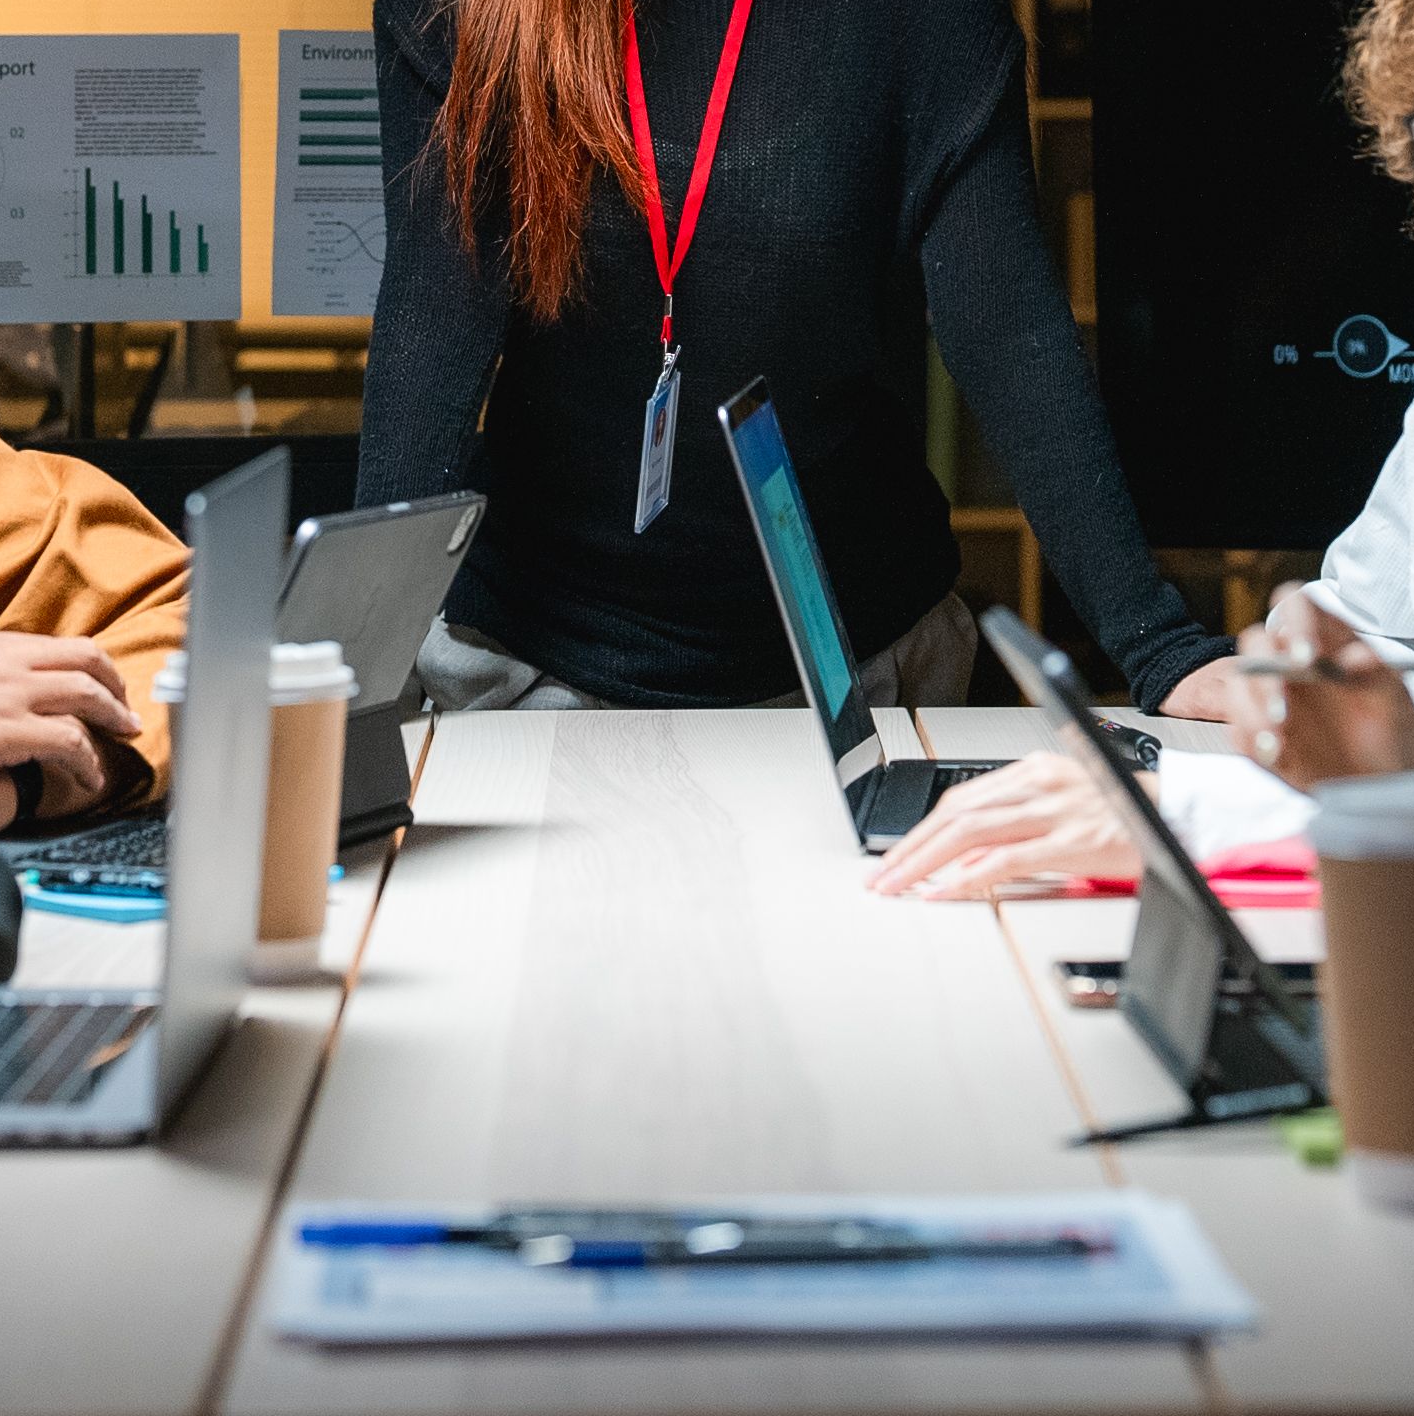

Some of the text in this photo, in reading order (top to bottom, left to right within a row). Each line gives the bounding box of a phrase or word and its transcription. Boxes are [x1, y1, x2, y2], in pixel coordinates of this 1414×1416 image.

[10, 127, 25, 139] 02
[10, 208, 25, 220] 03
[1273, 344, 1299, 365] 0%
